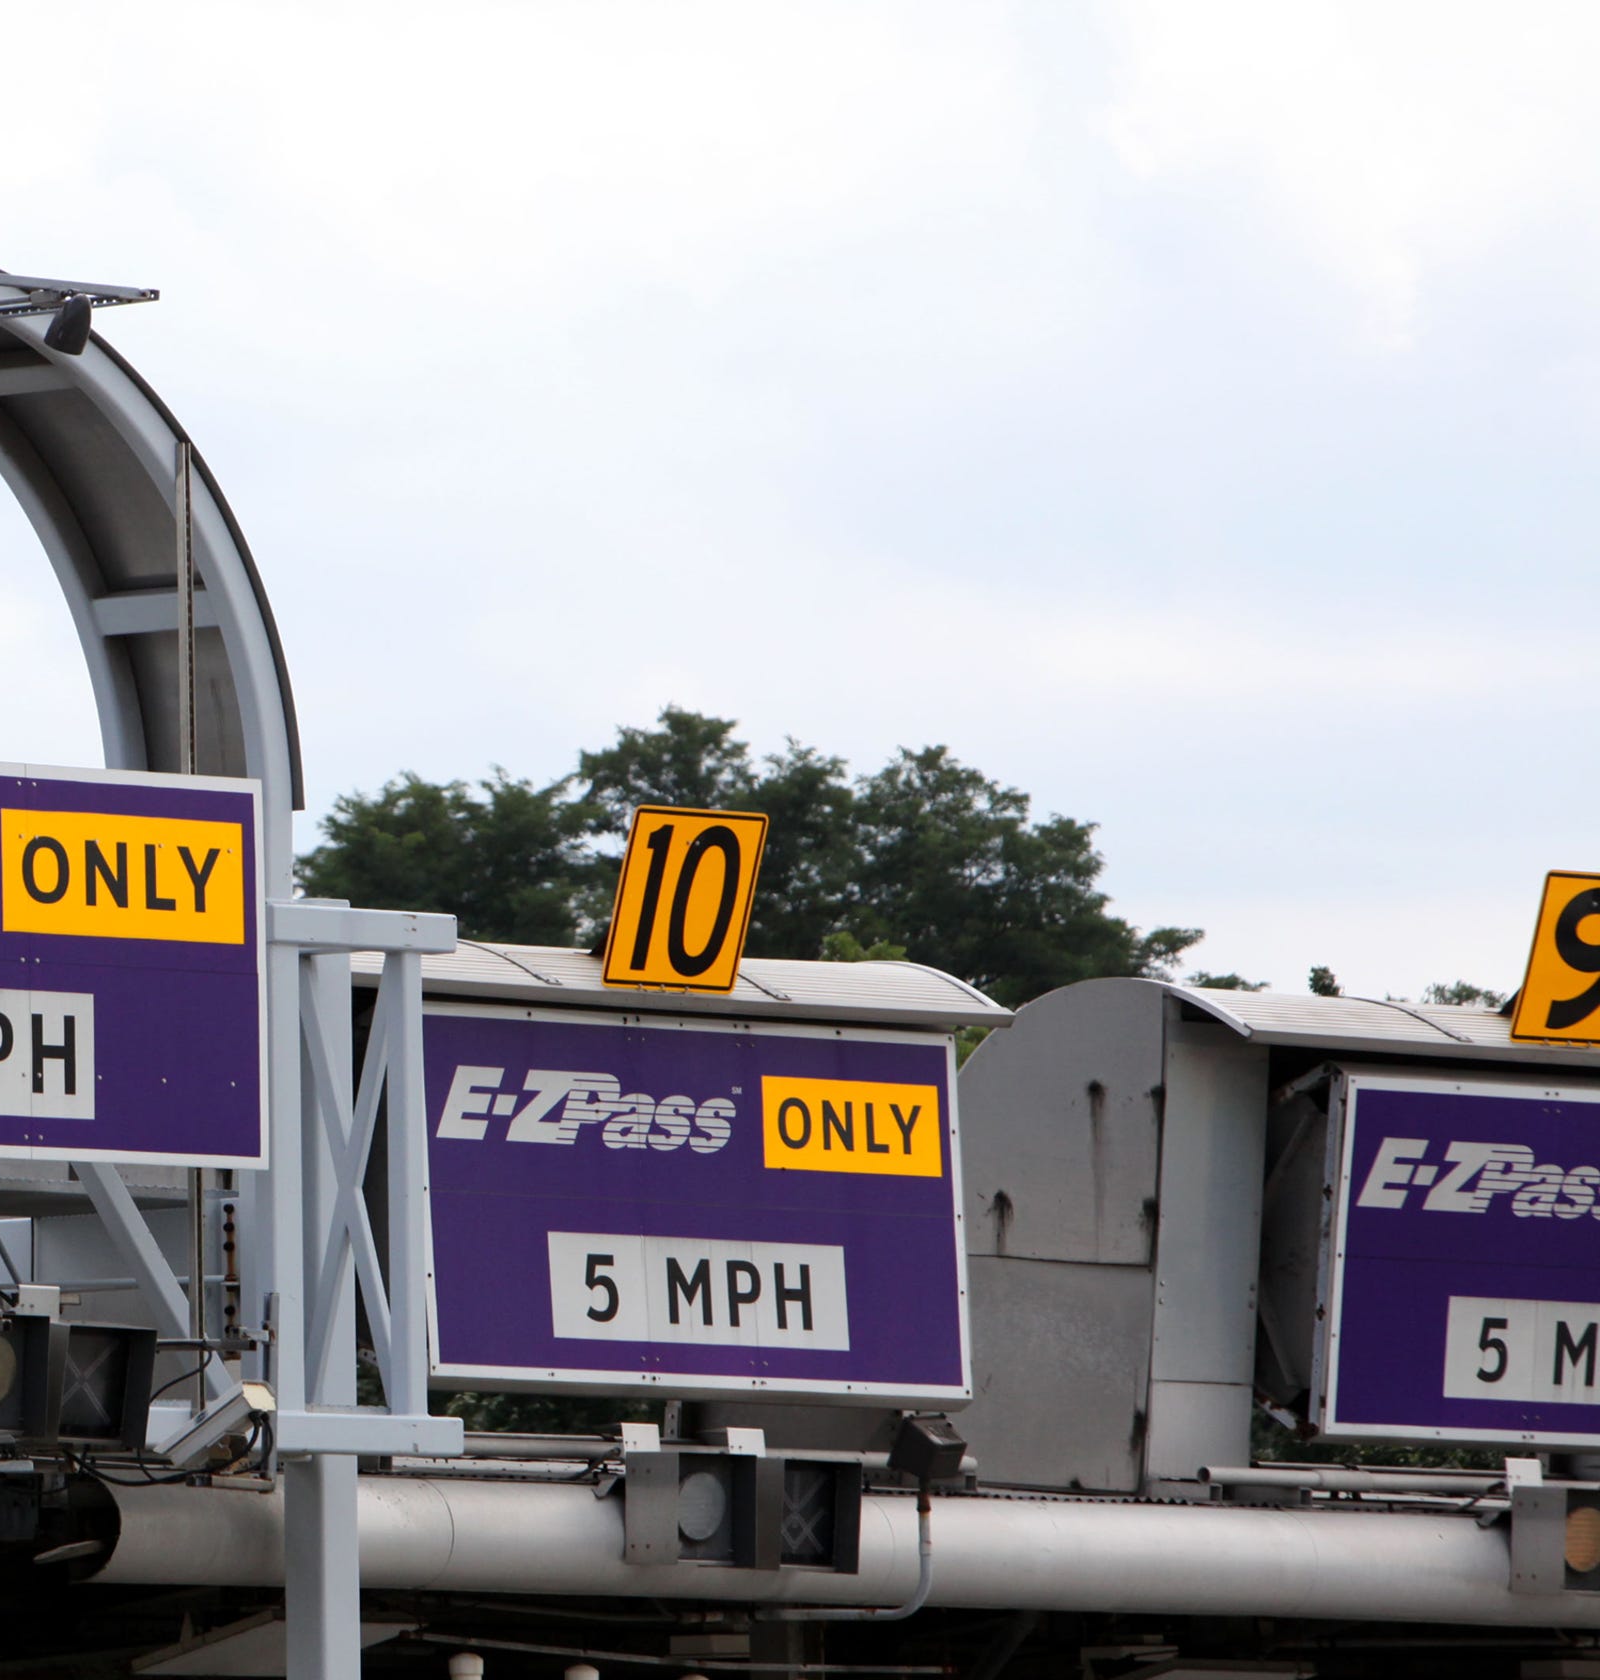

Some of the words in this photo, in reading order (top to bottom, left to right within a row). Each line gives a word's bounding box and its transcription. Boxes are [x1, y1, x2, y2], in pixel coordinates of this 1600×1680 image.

[21, 836, 220, 913] ONLY
[629, 823, 742, 977] 10
[436, 1065, 736, 1153] E-ZPass
[778, 1097, 921, 1155] ONLY
[1356, 1137, 1600, 1220] E-ZPas
[585, 1253, 619, 1322] 5
[666, 1257, 813, 1331] MPH
[1476, 1317, 1508, 1383] 5
